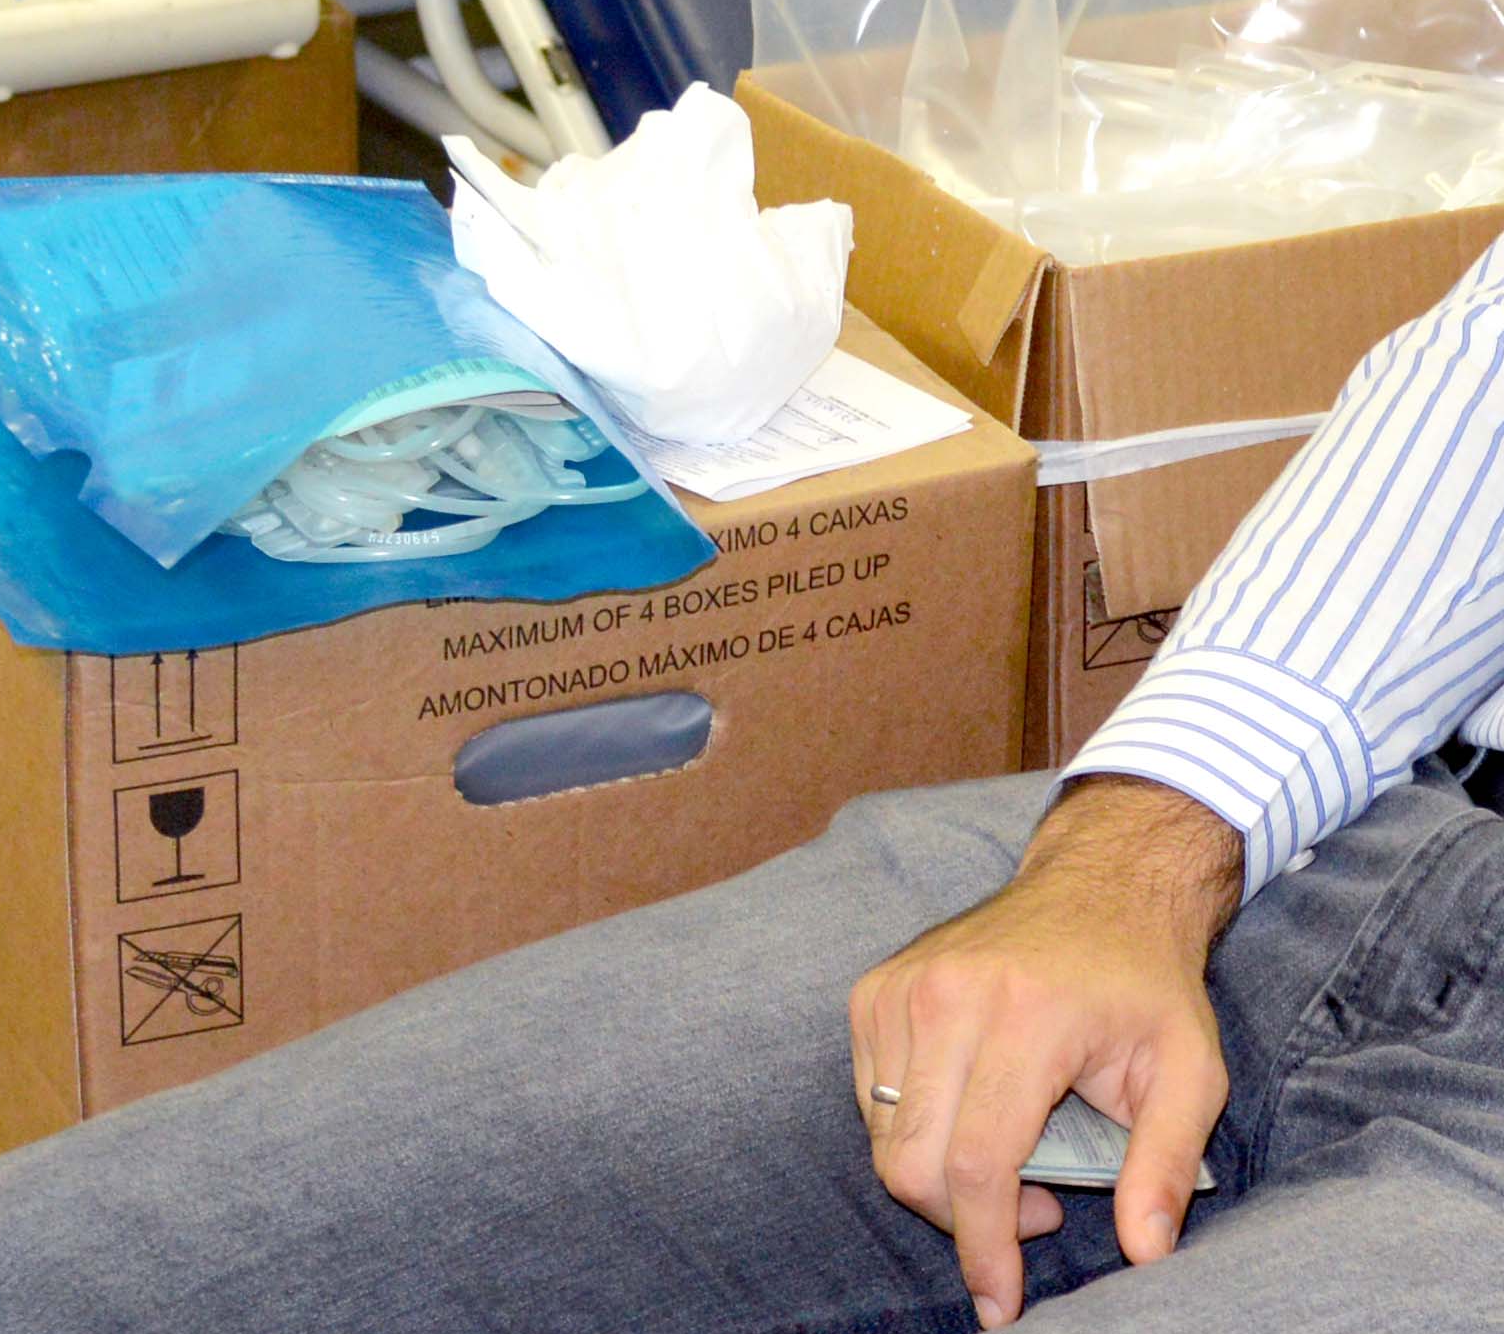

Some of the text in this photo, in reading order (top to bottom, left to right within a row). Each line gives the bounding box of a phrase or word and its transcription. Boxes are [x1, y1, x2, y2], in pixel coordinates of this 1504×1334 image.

[708, 497, 909, 555] XIMO 4 CAIXAS
[417, 601, 912, 720] AMONTONADO MÁXIMO DE 4 CAJAS
[443, 553, 891, 661] MAXIMUM OF 4 BOXES PILED UP
